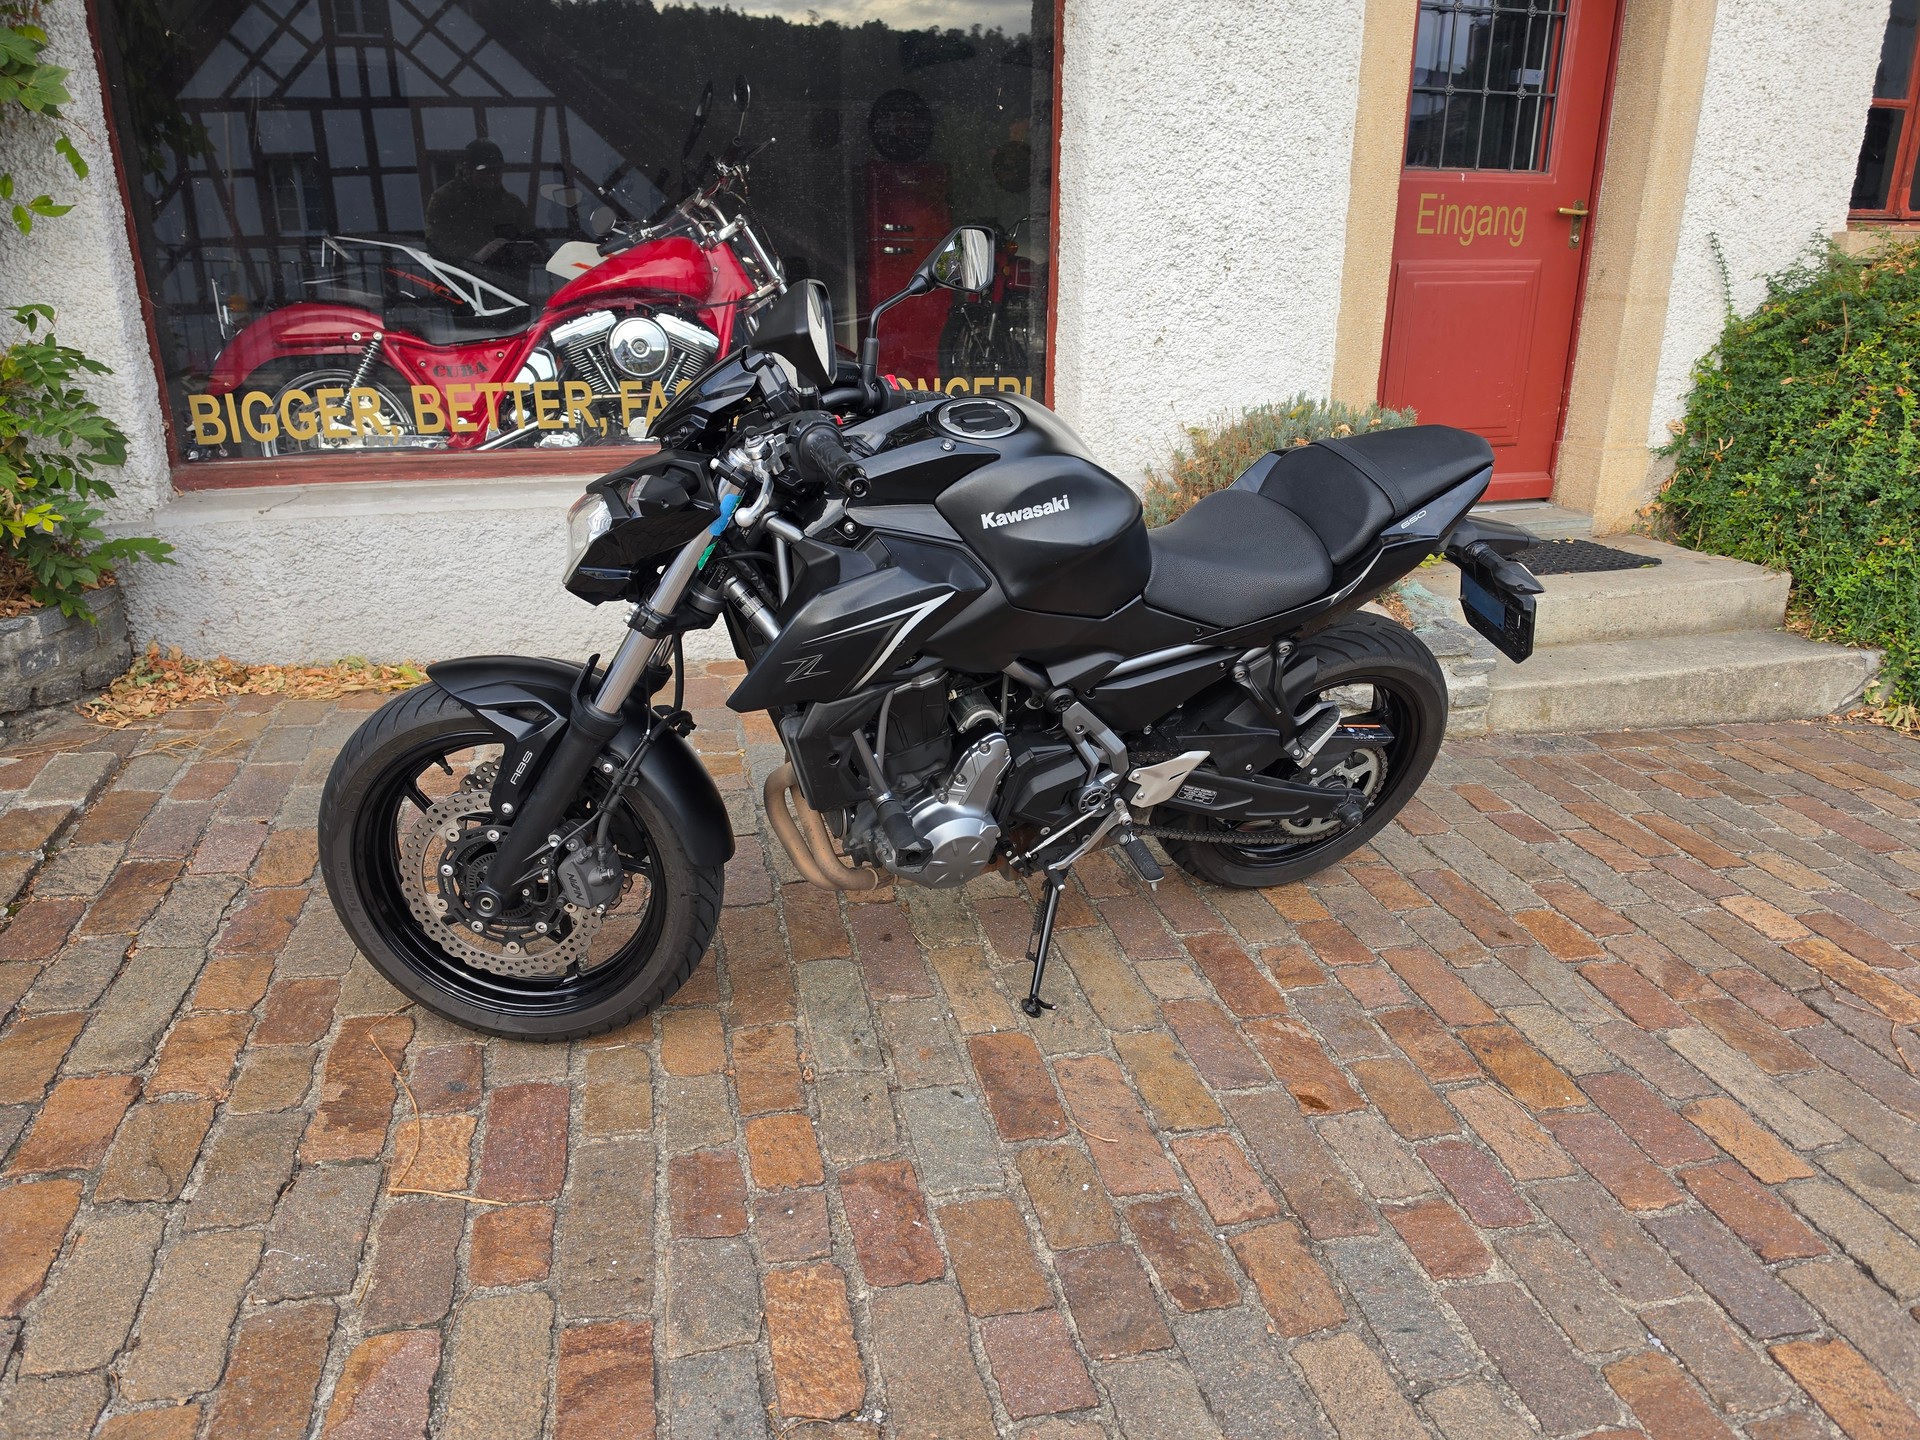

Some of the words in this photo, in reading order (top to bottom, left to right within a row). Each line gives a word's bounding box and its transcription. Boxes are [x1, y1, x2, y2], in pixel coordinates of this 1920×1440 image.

[1416, 193, 1527, 247] Eingang
[433, 361, 488, 378] CUBA
[188, 386, 399, 445] BIGGER,
[411, 381, 607, 437] BETTER,
[981, 494, 1070, 529] Kawasaki
[1401, 510, 1426, 529] 650
[510, 751, 533, 785] ABS
